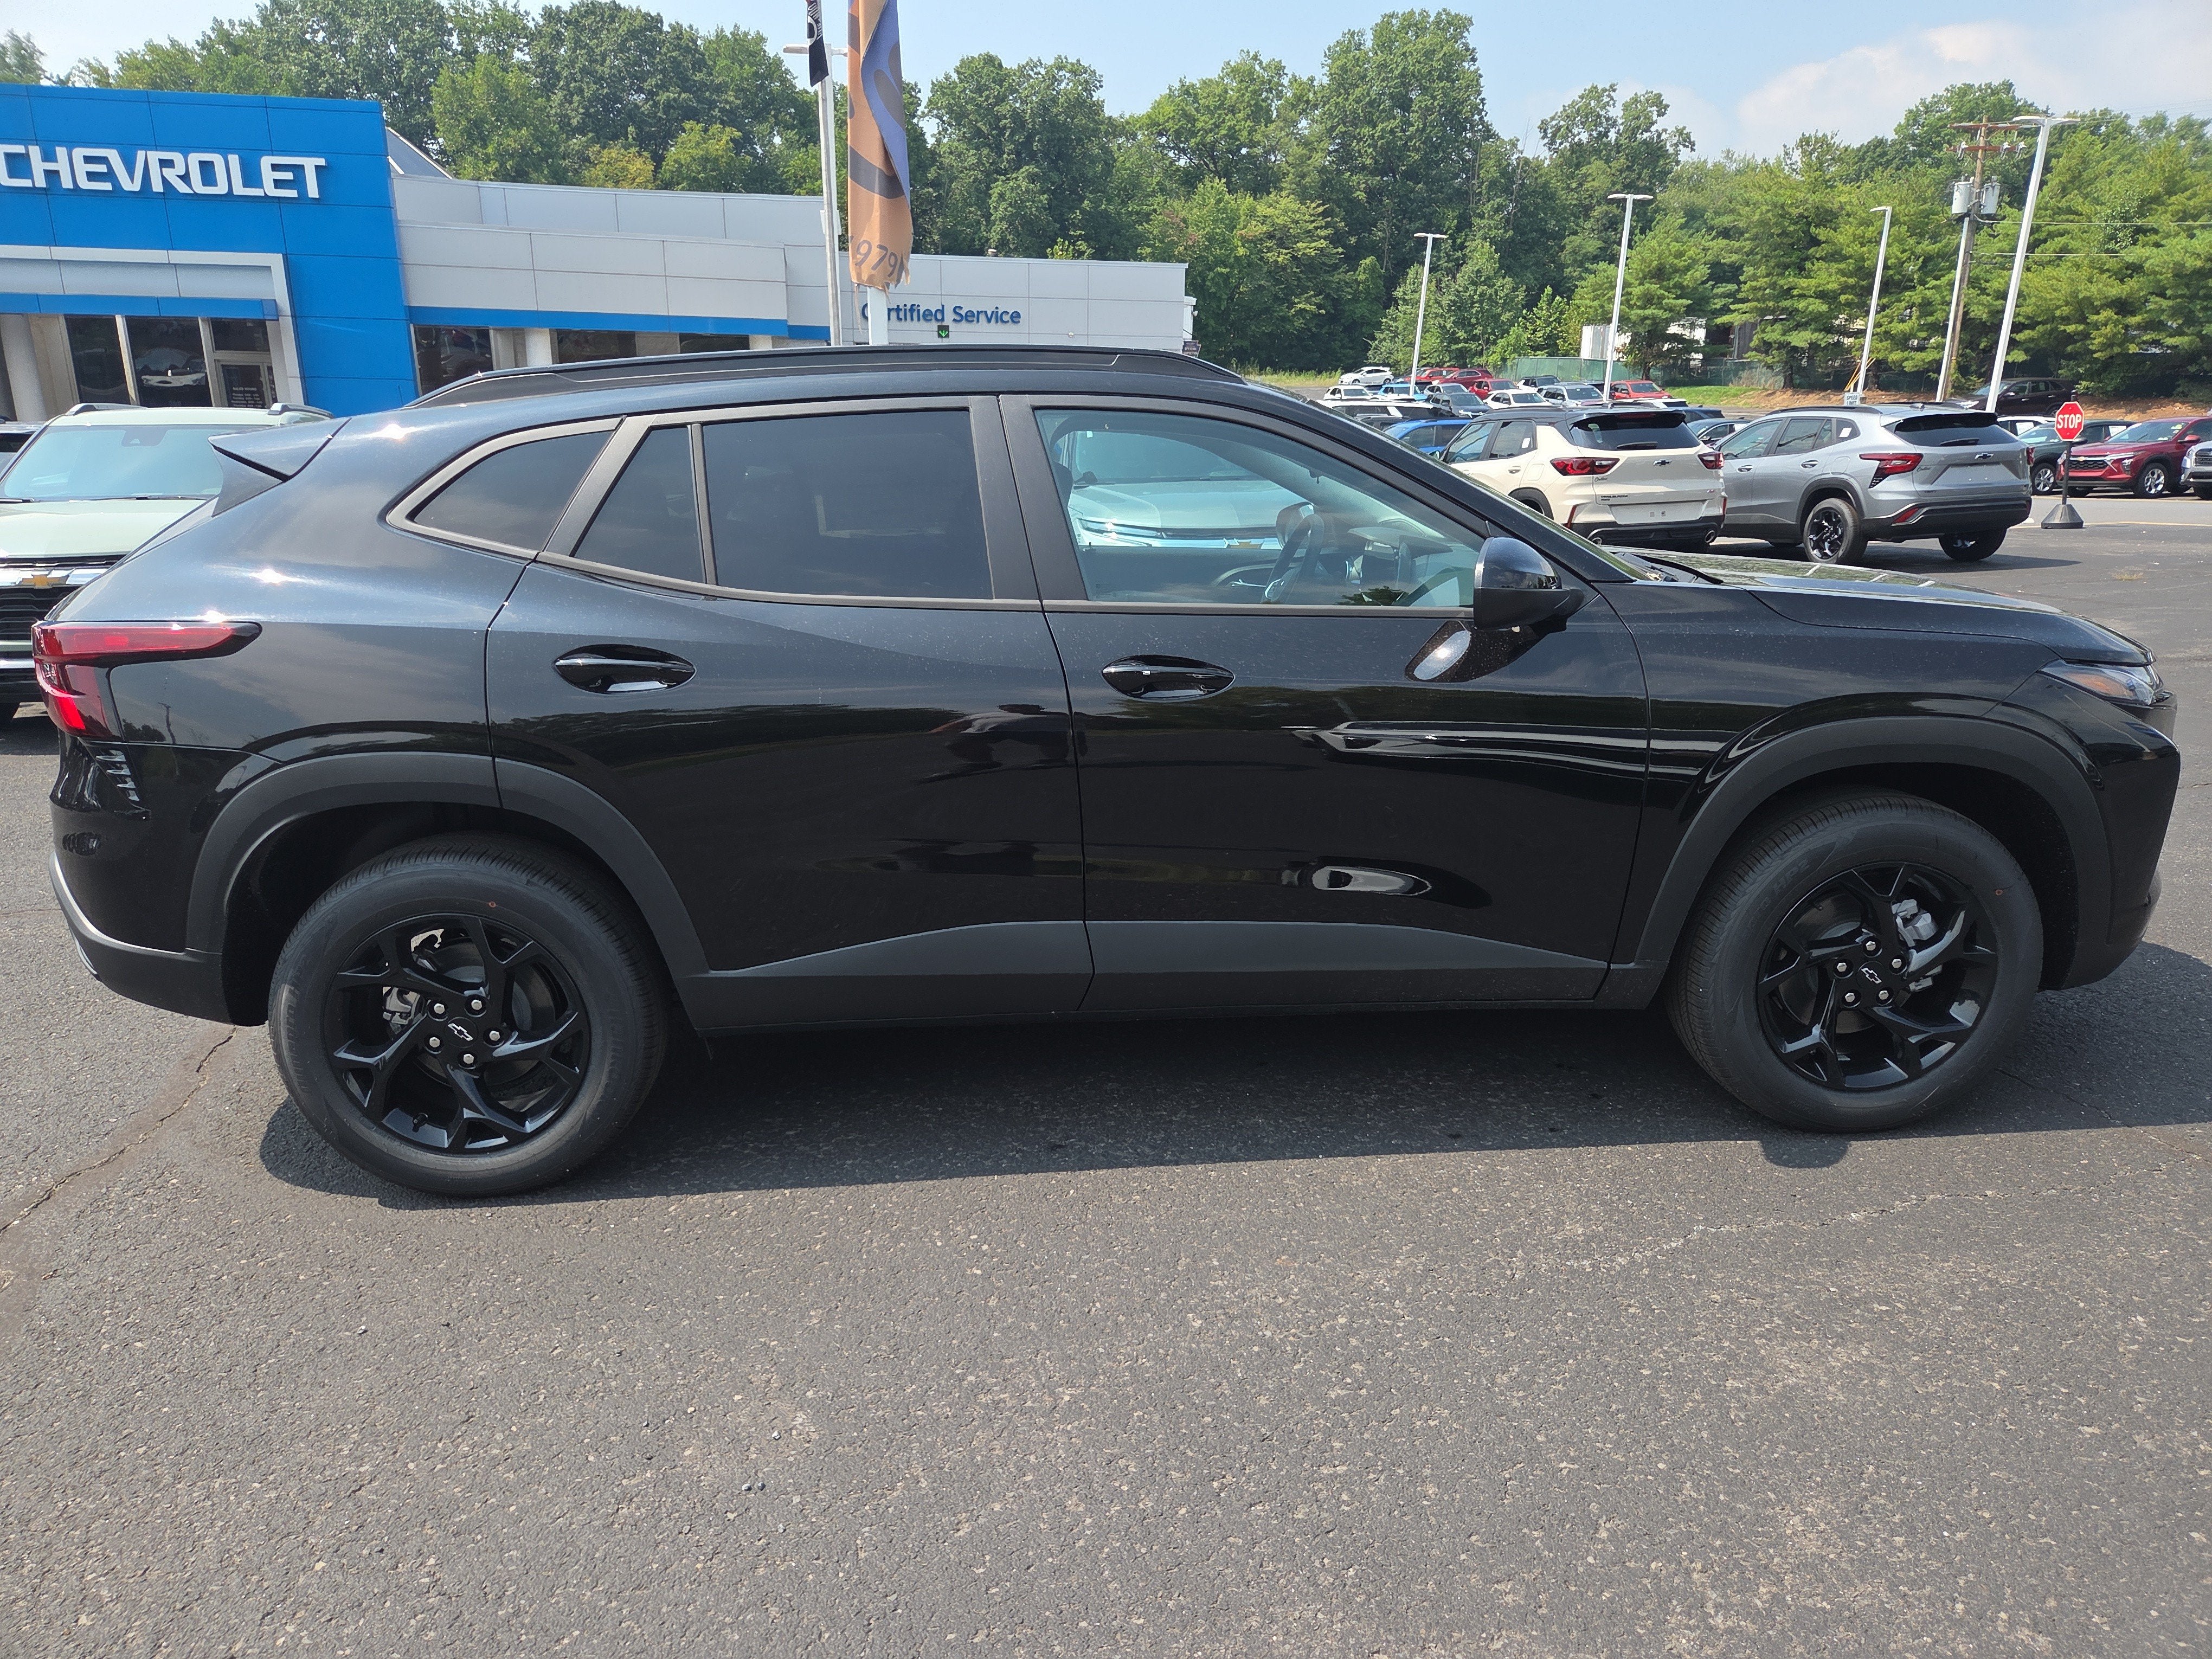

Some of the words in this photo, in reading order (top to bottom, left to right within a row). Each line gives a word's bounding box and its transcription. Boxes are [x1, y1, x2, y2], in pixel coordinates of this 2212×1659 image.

[0, 144, 326, 198] CHEVROLET
[861, 303, 945, 323] Crtified
[952, 305, 1021, 324] Service
[2057, 414, 2082, 429] STOP
